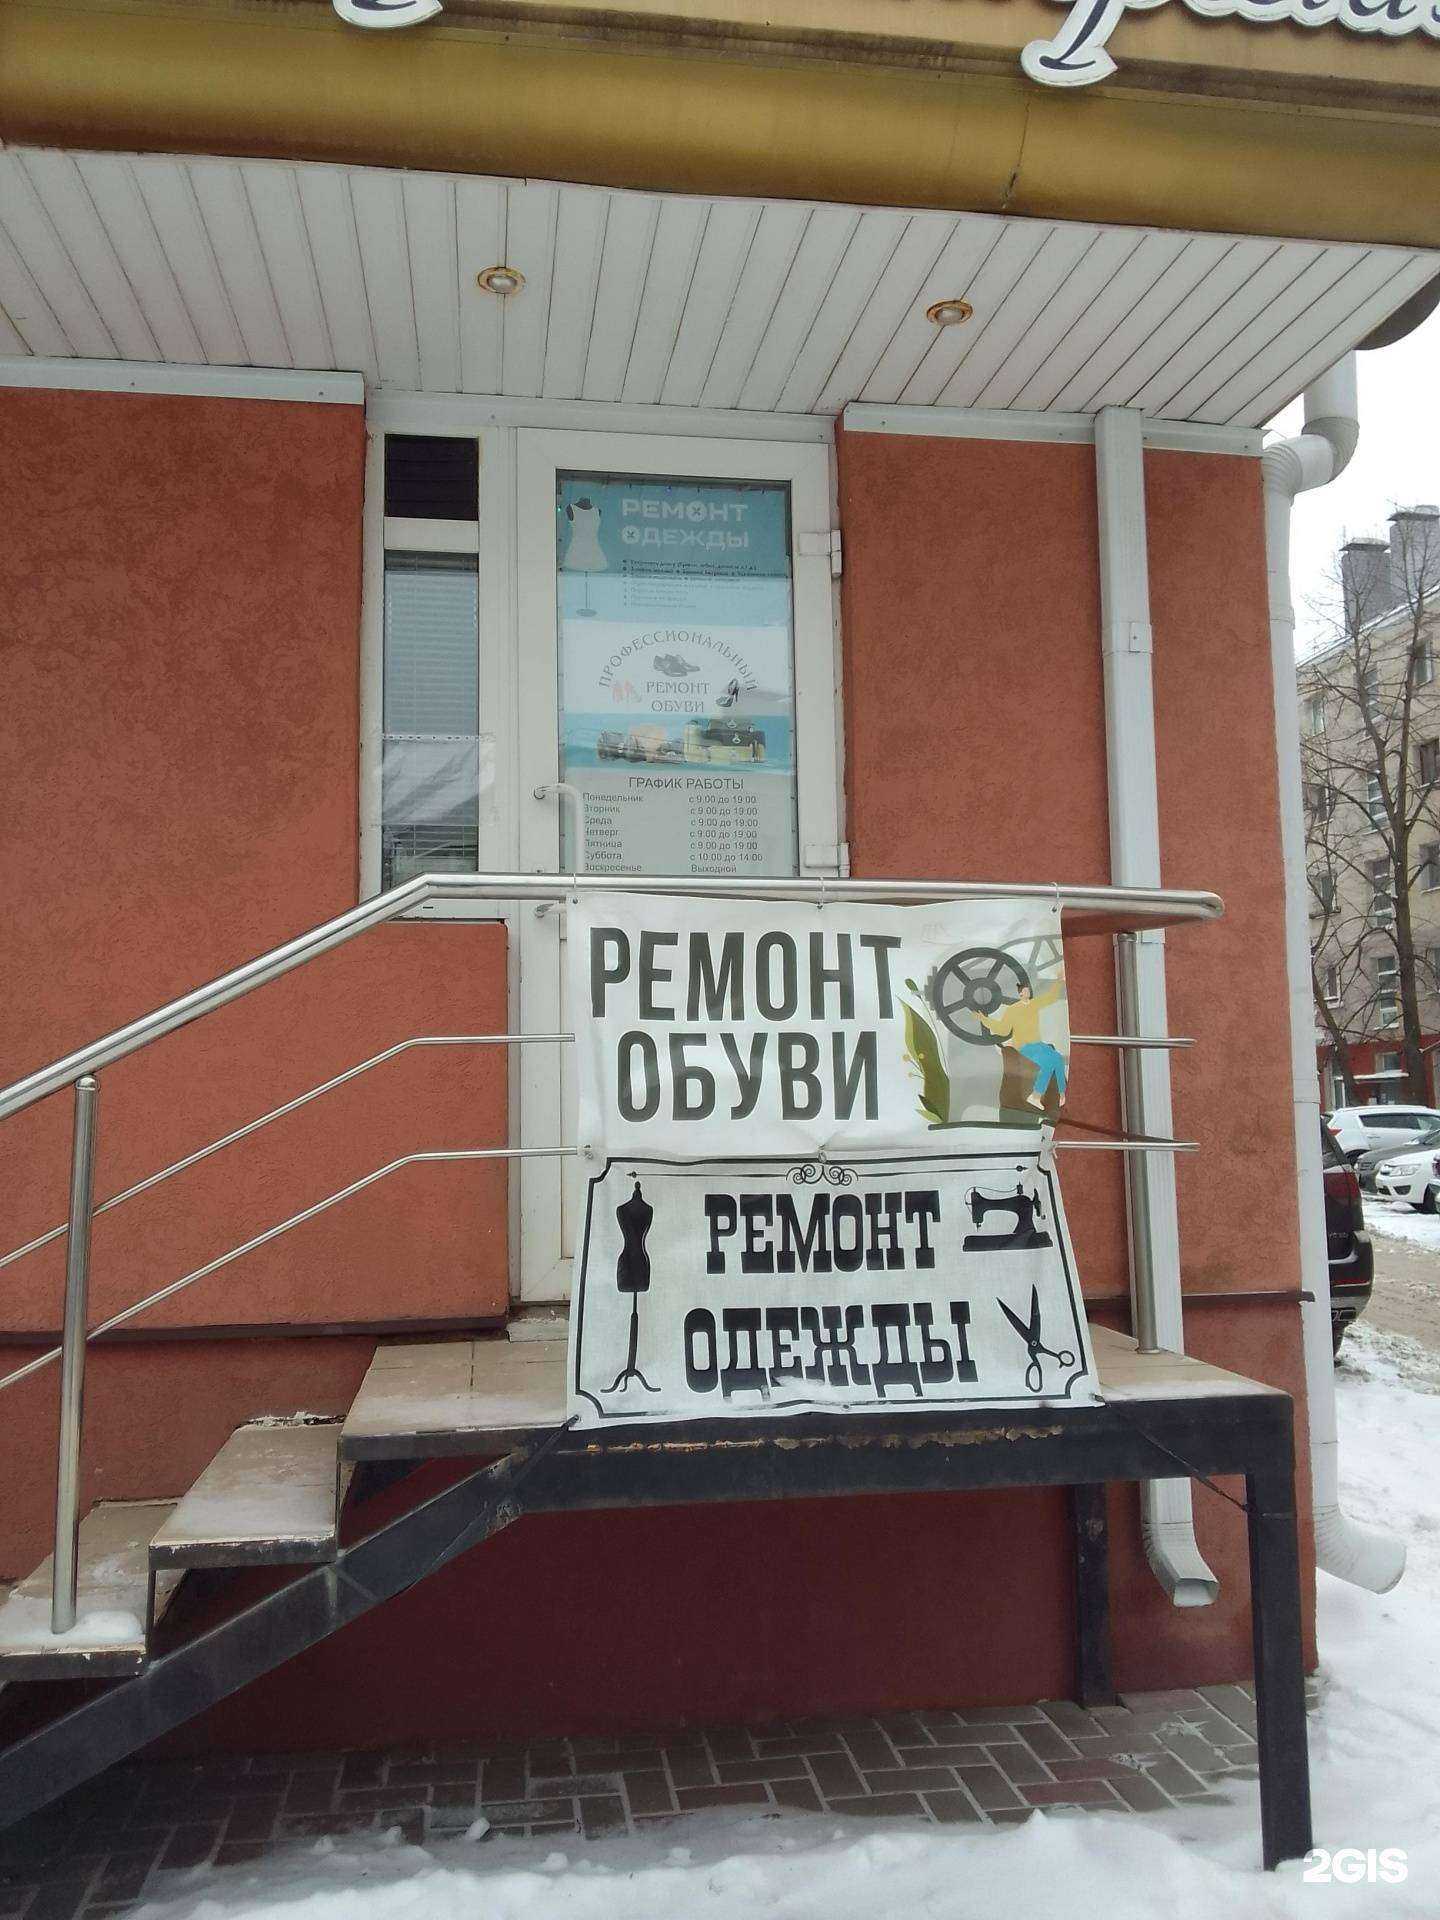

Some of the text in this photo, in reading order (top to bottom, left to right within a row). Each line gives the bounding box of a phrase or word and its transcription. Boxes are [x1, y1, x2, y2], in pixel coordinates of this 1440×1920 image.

[622, 499, 749, 522] РЕМОНТ
[622, 525, 749, 550] ОДЕЖДЫ
[646, 681, 712, 695] РЕМОНТ
[651, 699, 705, 713] ОБУВИ
[628, 777, 744, 790] ГРАФИК РАБОТЫ
[582, 792, 644, 802] Понедельник
[724, 854, 736, 862] до
[691, 864, 737, 874] Выходной
[590, 927, 902, 1022] РЕМОНТ
[615, 1030, 880, 1123] ОБУВИ
[704, 1190, 941, 1275] РЕМОНТ
[683, 1301, 980, 1399] ОДЕЖДЫ
